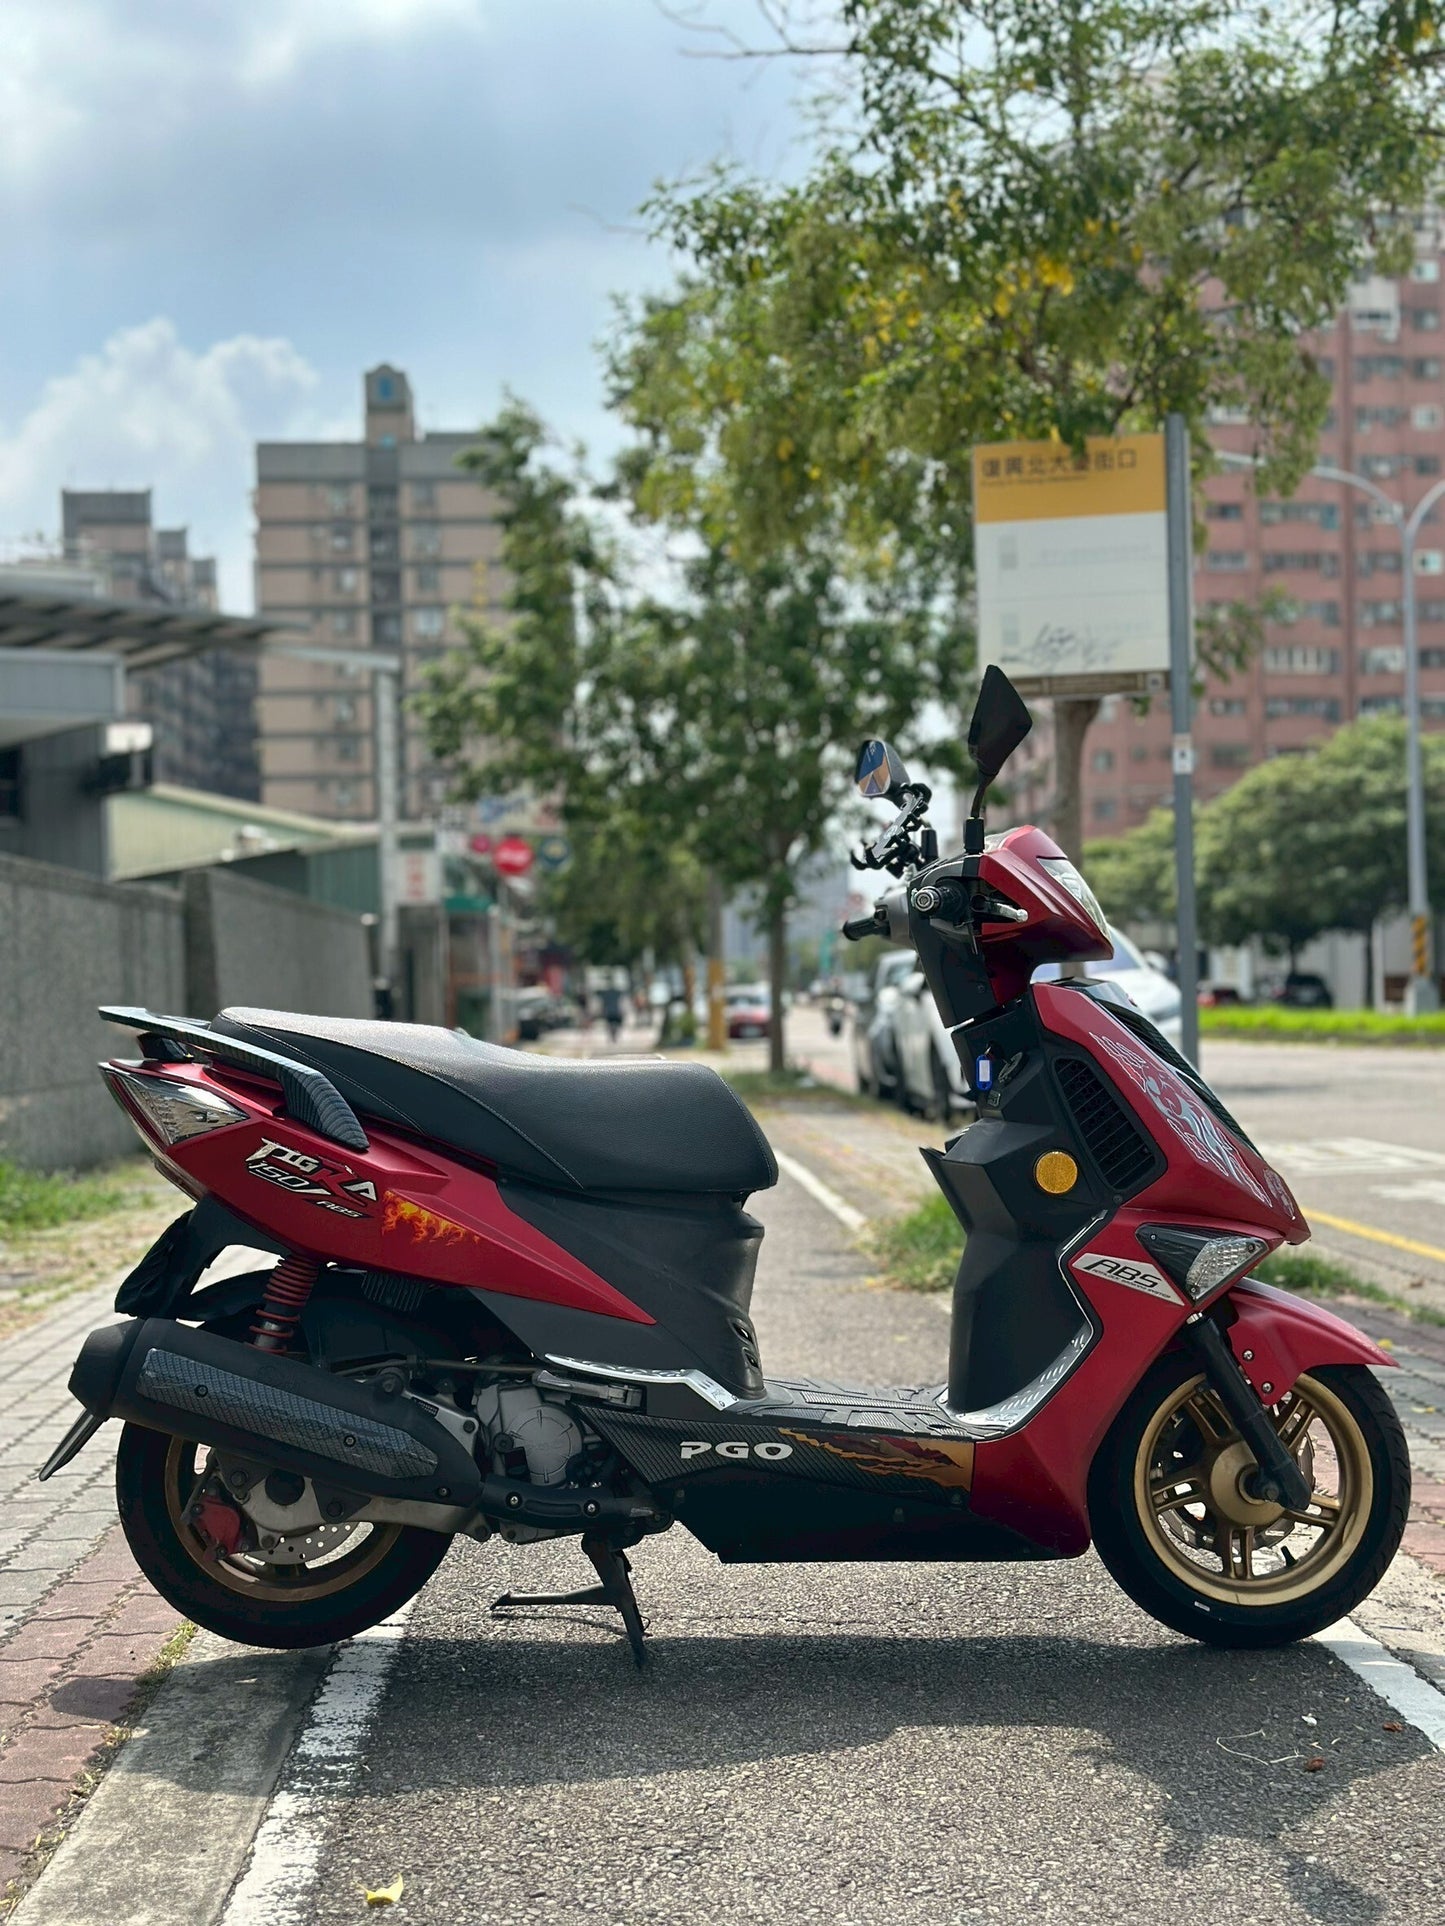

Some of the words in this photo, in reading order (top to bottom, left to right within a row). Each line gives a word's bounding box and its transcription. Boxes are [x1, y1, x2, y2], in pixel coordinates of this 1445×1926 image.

[248, 1161, 310, 1188] 150
[316, 1201, 363, 1218] ABS
[1083, 1259, 1162, 1288] ABS
[680, 1441, 793, 1460] PGO
